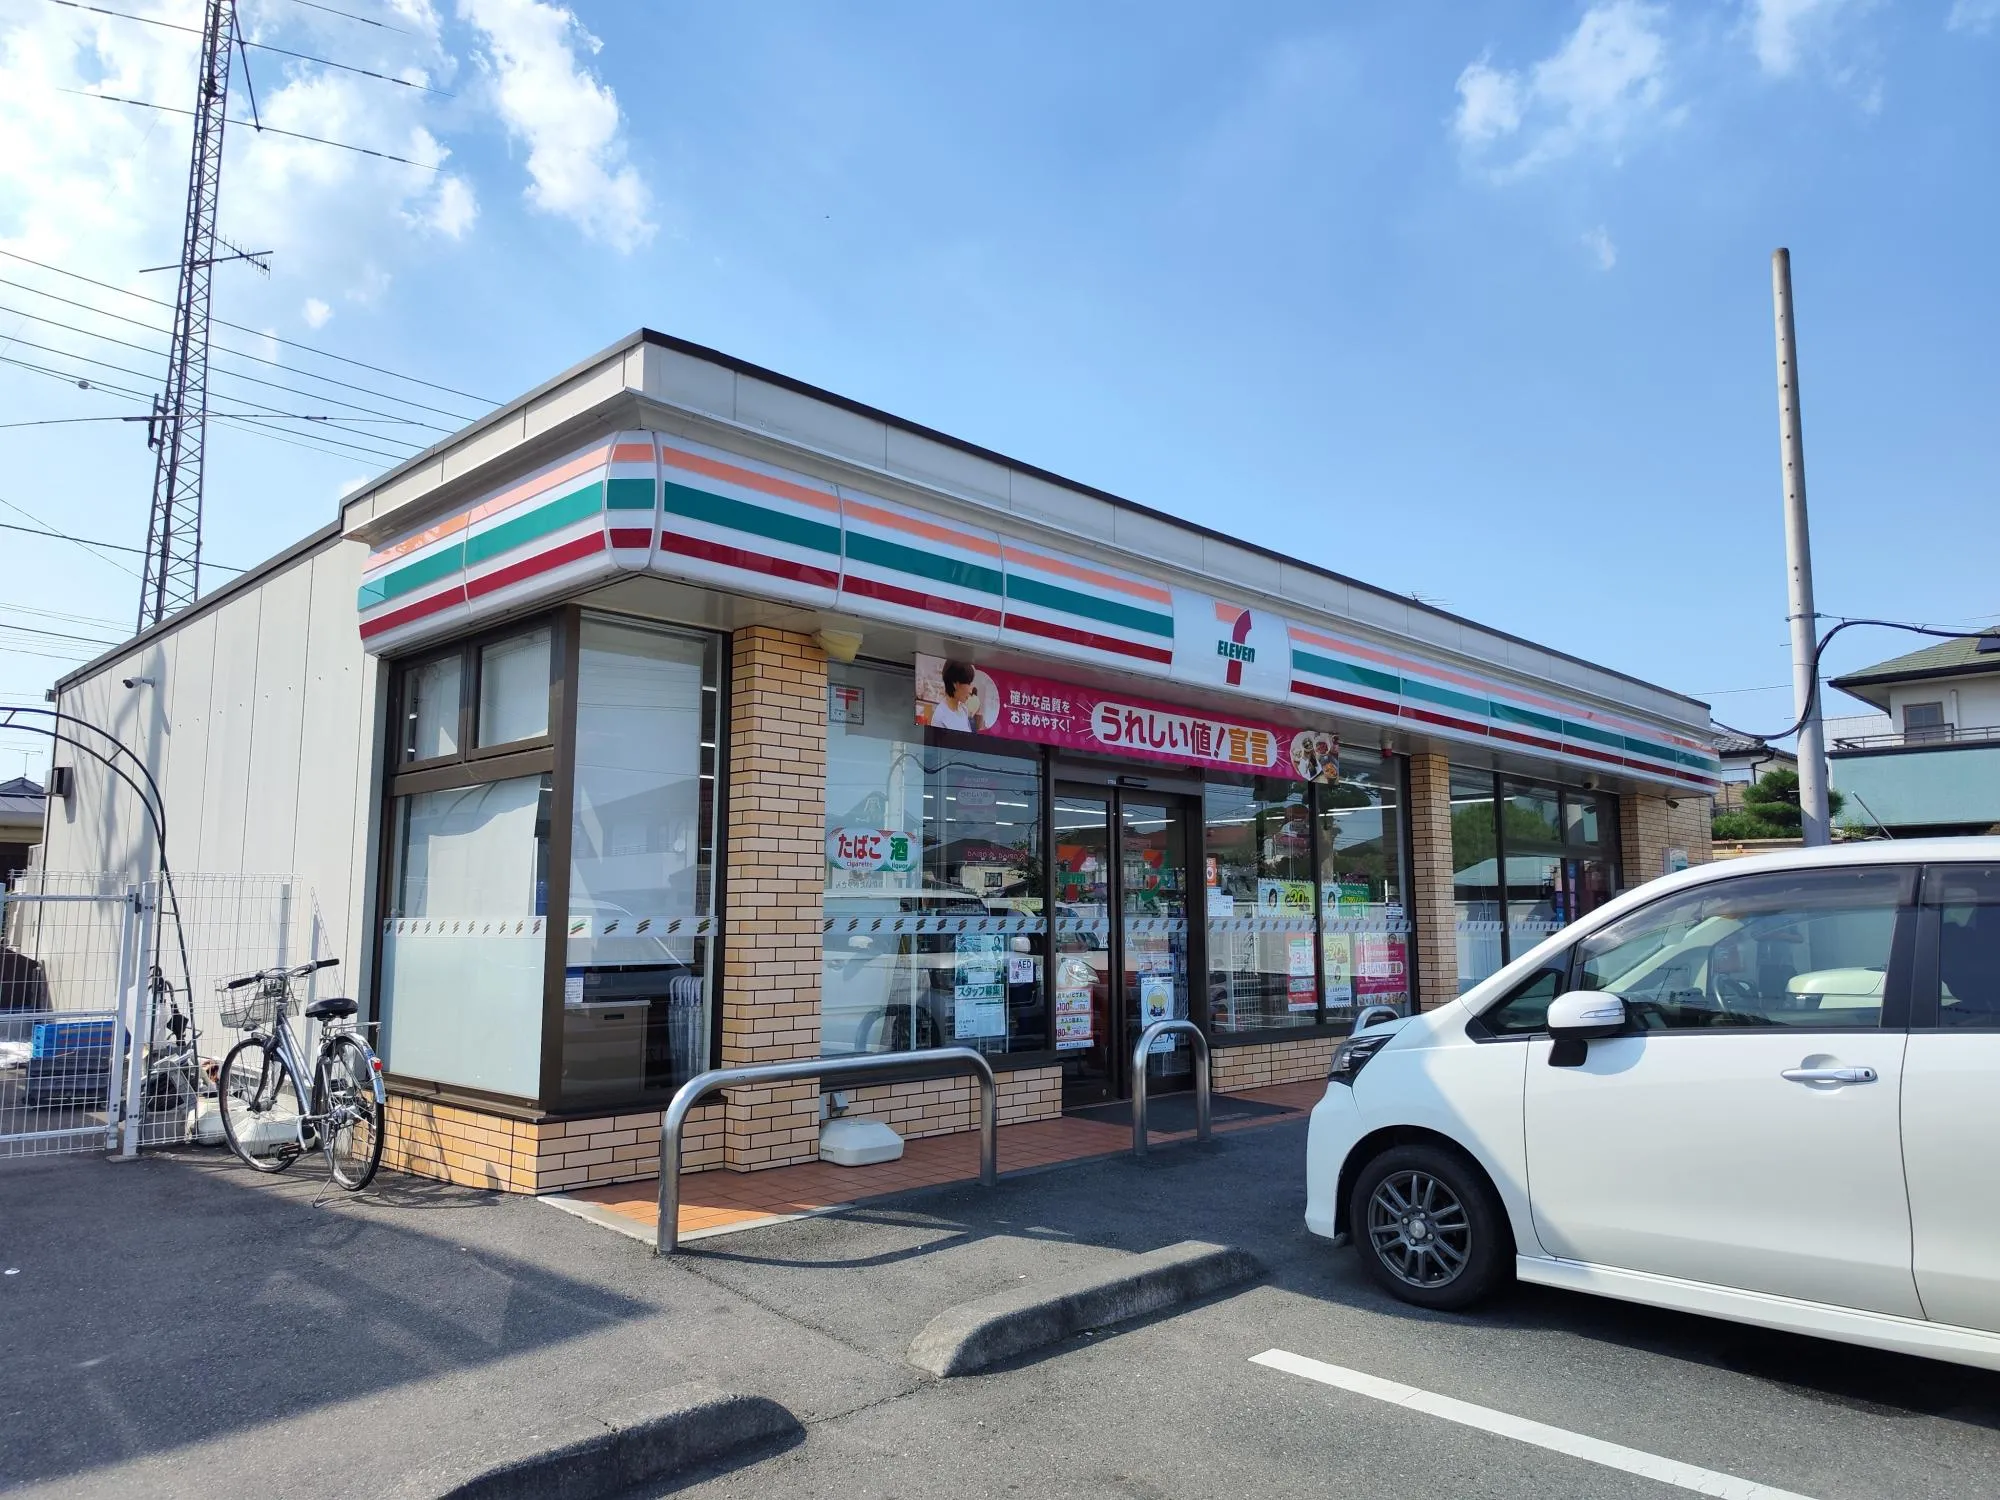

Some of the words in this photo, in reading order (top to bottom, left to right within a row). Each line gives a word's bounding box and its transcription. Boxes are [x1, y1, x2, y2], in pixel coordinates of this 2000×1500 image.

[1010, 690, 1070, 713] 確かな品質を
[1010, 711, 1070, 733] お求めやすく!
[838, 833, 881, 859] たばこ
[890, 836, 909, 861] 酒
[1018, 960, 1031, 968] AED
